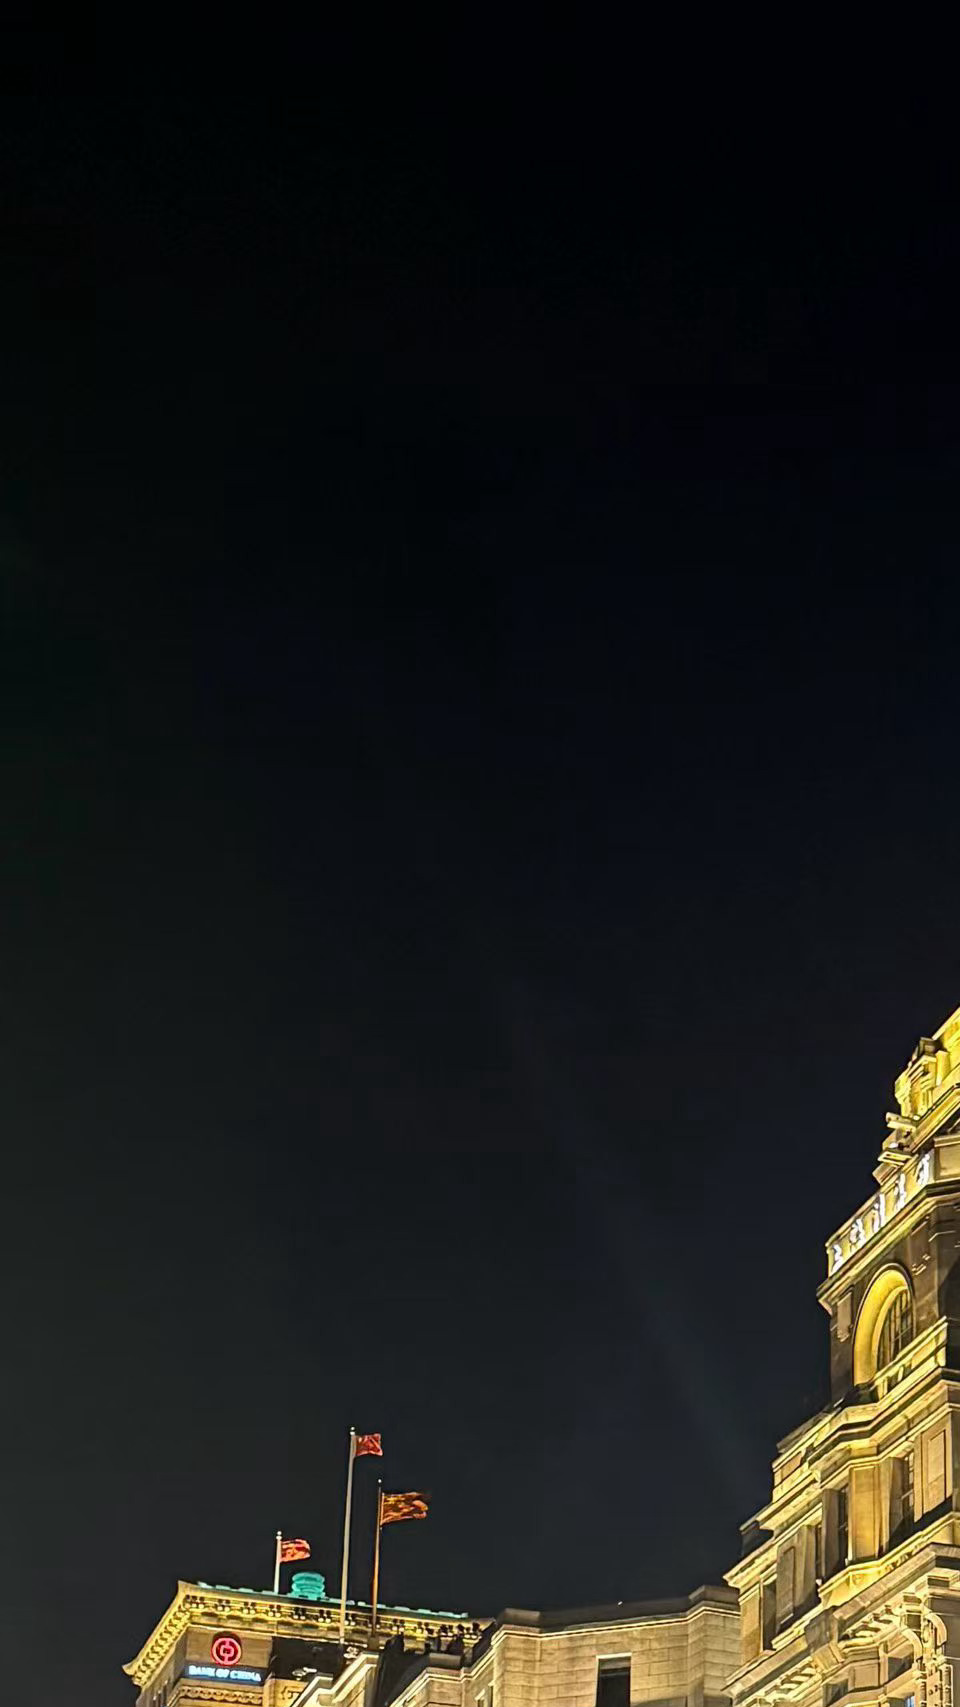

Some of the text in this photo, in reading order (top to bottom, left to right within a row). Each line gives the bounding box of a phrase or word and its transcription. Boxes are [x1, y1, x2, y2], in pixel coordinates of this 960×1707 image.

[188, 1665, 262, 1682] BANK OF CHINA
